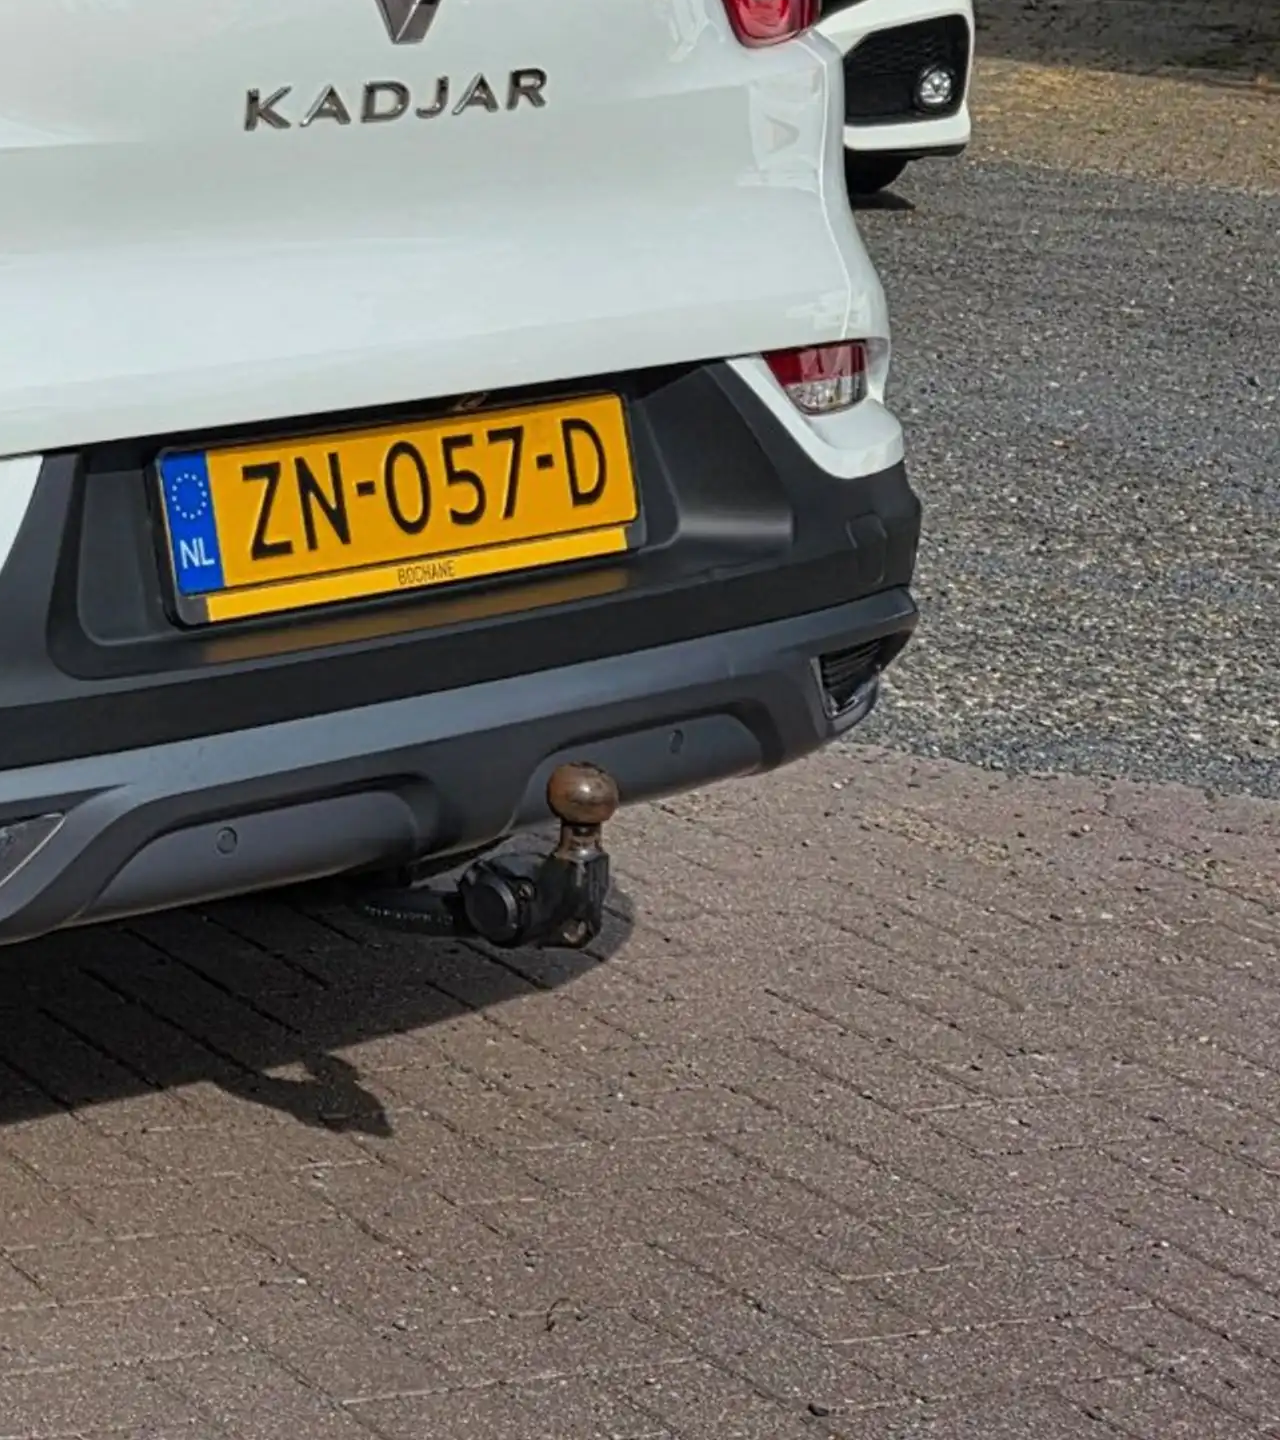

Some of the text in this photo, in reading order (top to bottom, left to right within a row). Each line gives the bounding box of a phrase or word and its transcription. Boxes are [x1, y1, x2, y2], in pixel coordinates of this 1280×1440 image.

[243, 67, 547, 131] KADJAR
[242, 418, 607, 561] ZN-057-D
[180, 536, 215, 569] NL
[397, 560, 455, 585] BOCHANE
